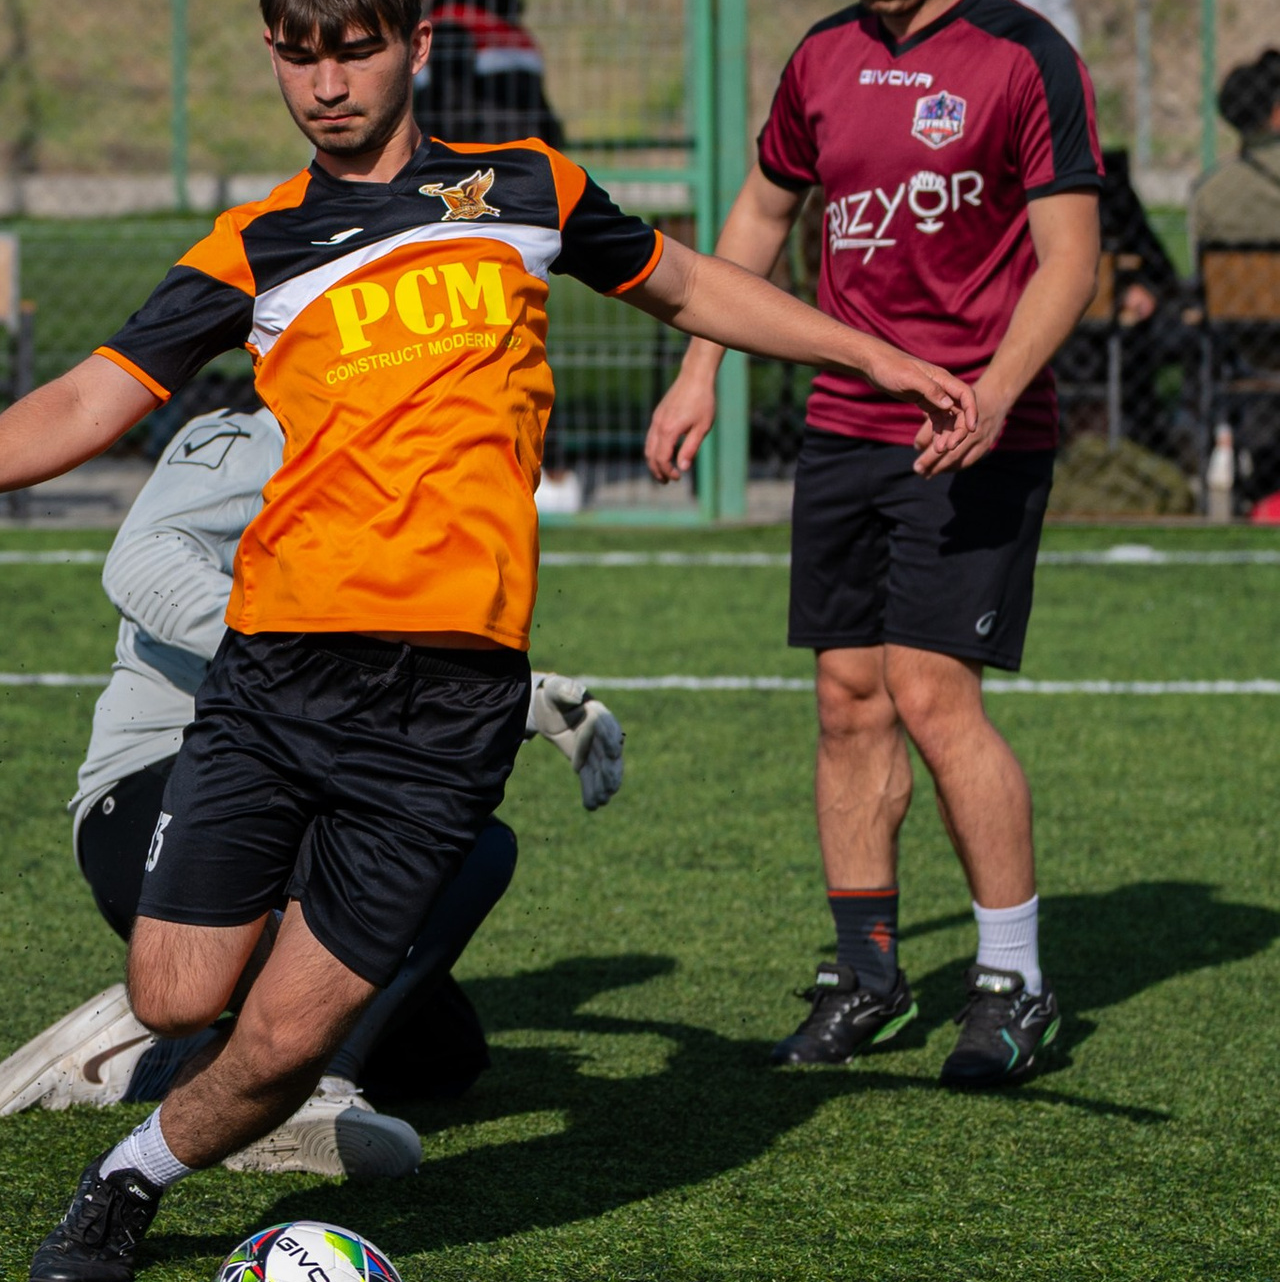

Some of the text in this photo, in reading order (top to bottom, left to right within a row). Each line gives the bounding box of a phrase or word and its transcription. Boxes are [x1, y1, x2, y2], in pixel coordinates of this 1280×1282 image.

[859, 69, 933, 89] GIVOVA
[325, 262, 513, 355] PCM
[326, 343, 423, 385] CONSTRUCT
[427, 333, 496, 355] MODERN
